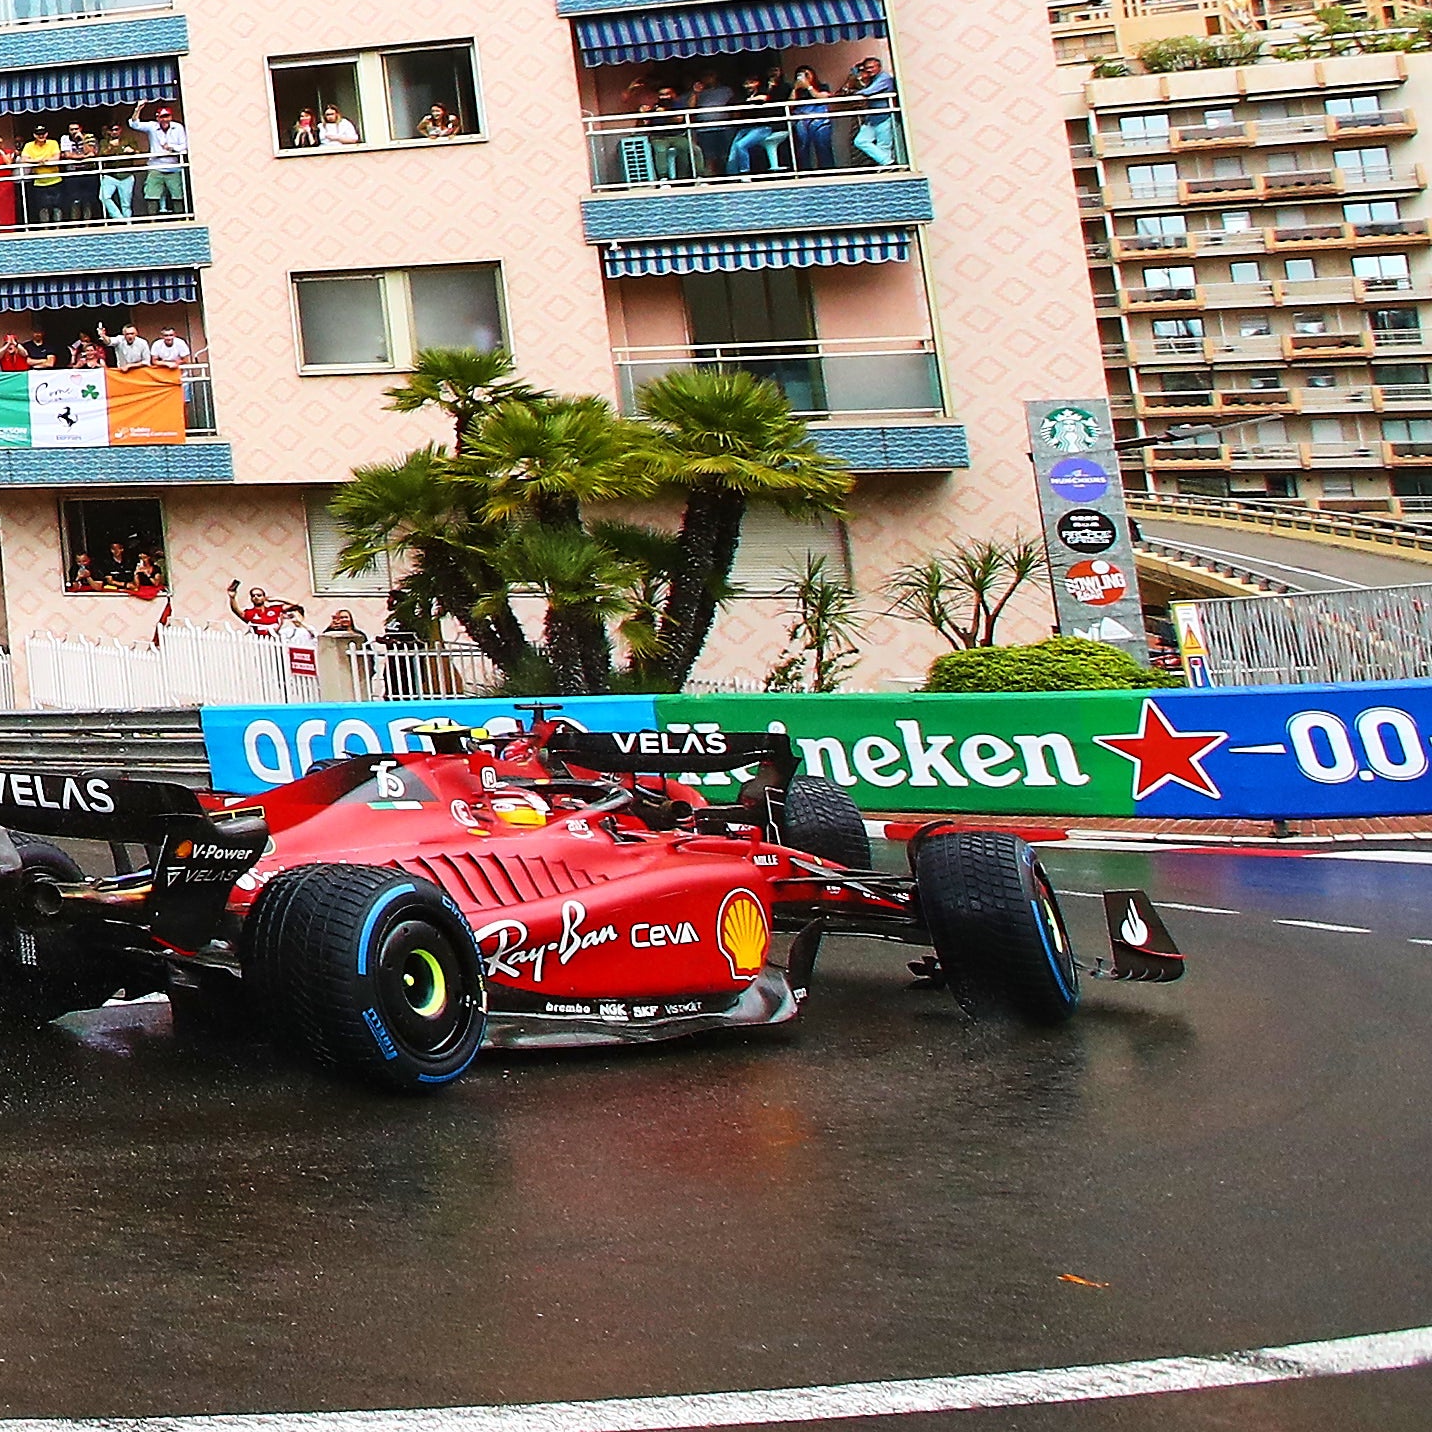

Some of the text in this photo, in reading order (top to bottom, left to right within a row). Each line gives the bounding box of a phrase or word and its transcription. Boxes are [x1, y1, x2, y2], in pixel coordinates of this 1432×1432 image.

[612, 732, 727, 754] VELAS
[190, 844, 253, 861] V-Power
[183, 868, 237, 883] VELAS
[475, 900, 618, 982] Ray-Ban
[545, 1001, 591, 1014] brembo
[599, 1003, 626, 1016] NGK
[632, 1005, 659, 1017] SKF
